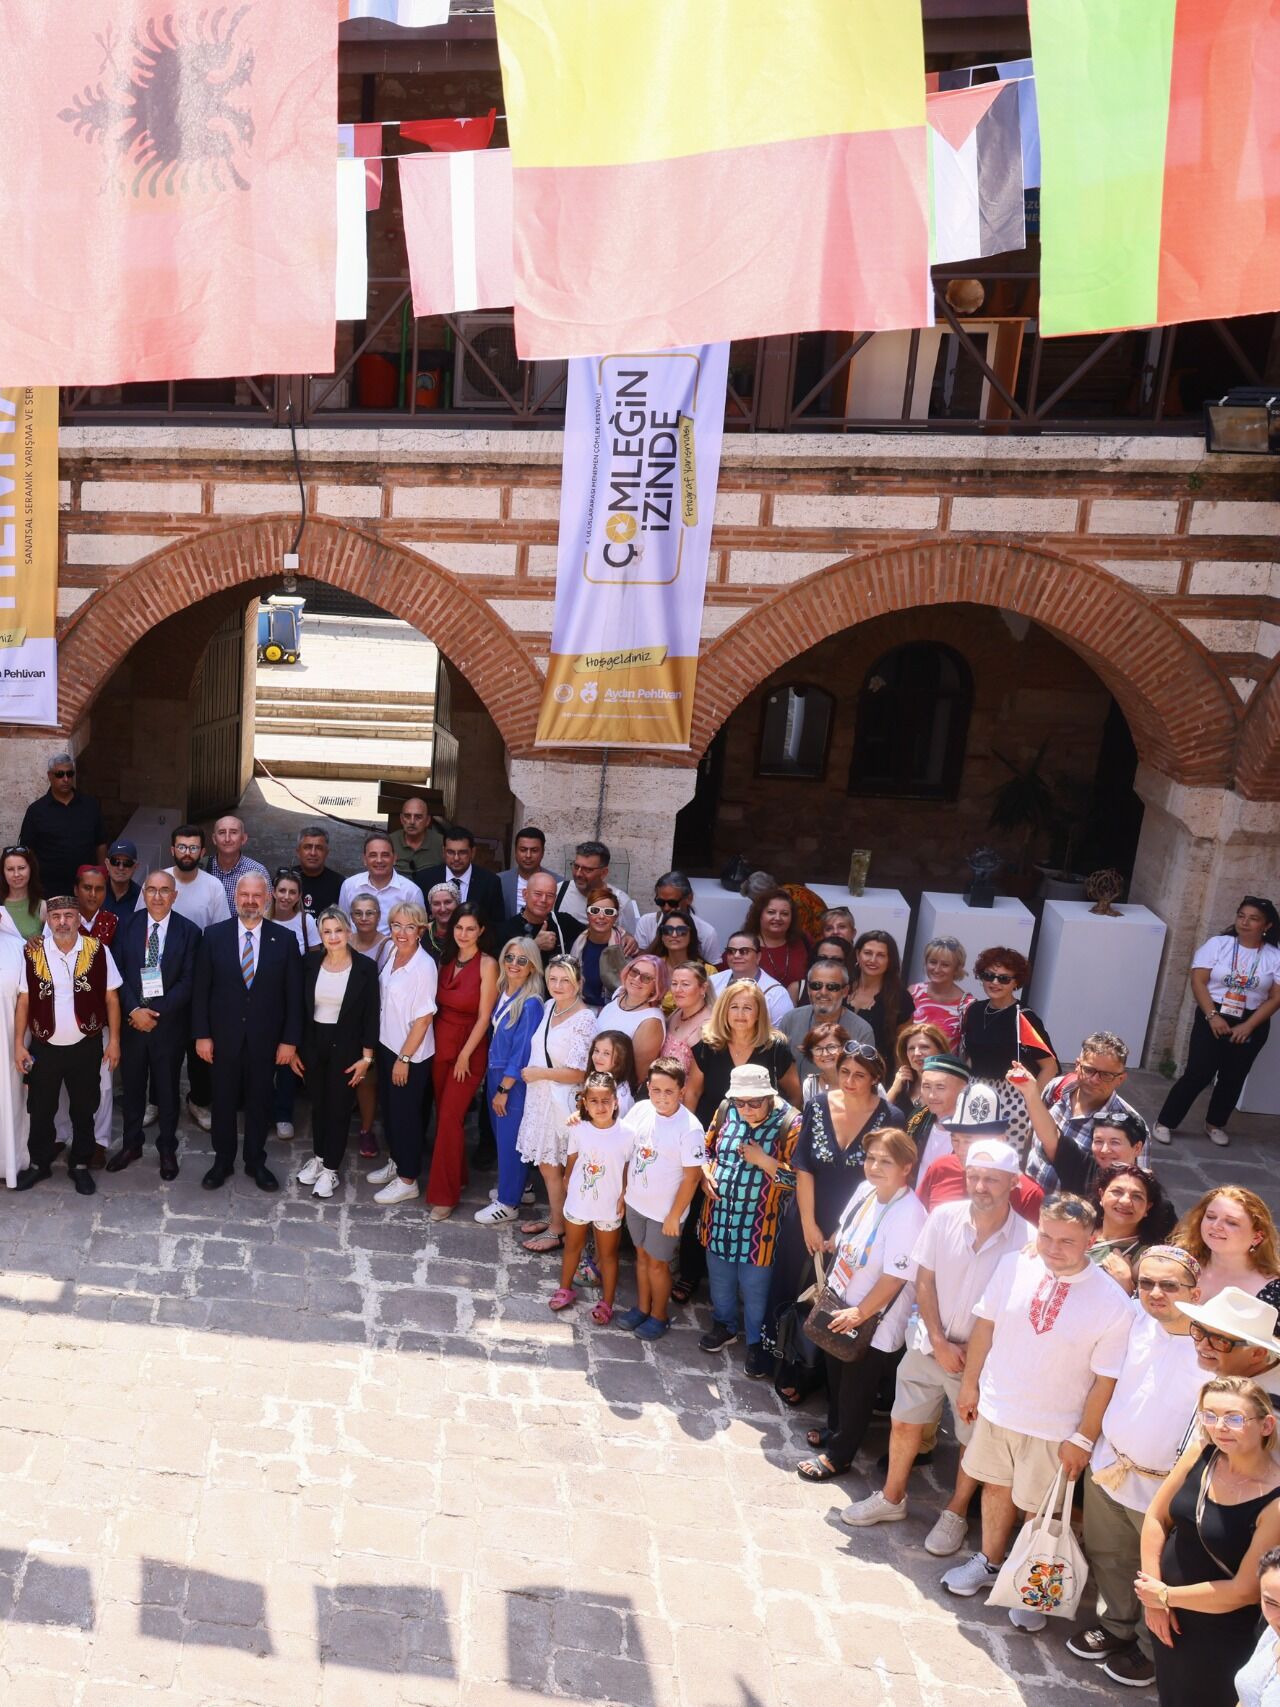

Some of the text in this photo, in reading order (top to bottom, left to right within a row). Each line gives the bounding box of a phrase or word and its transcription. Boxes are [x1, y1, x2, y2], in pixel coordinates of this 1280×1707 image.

[24, 386, 34, 408] SER
[24, 409, 34, 421] VE
[24, 423, 35, 468] YARIŞMA
[591, 454, 600, 488] MENEMEN
[24, 518, 33, 565] SANATSAL
[4, 669, 46, 678] Pehlivan
[604, 688, 682, 700] Aydın Pehlivan
